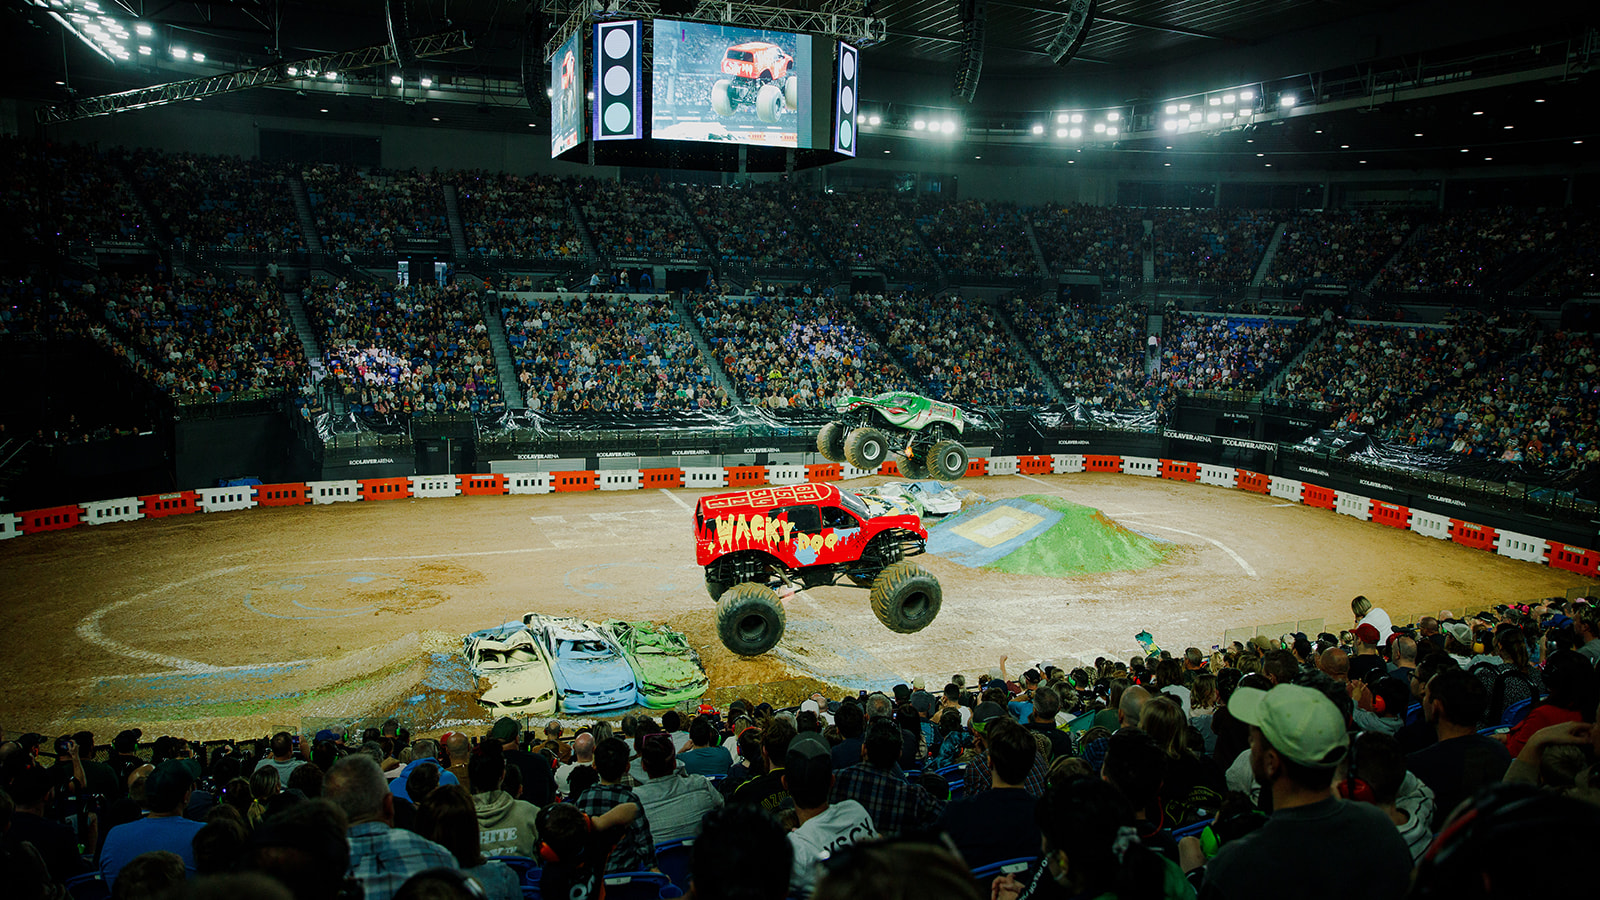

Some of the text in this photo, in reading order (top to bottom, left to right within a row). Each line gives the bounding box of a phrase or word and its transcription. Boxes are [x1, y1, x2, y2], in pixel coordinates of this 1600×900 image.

[715, 514, 838, 555] WACKY DOO
[480, 827, 517, 844] HITE
